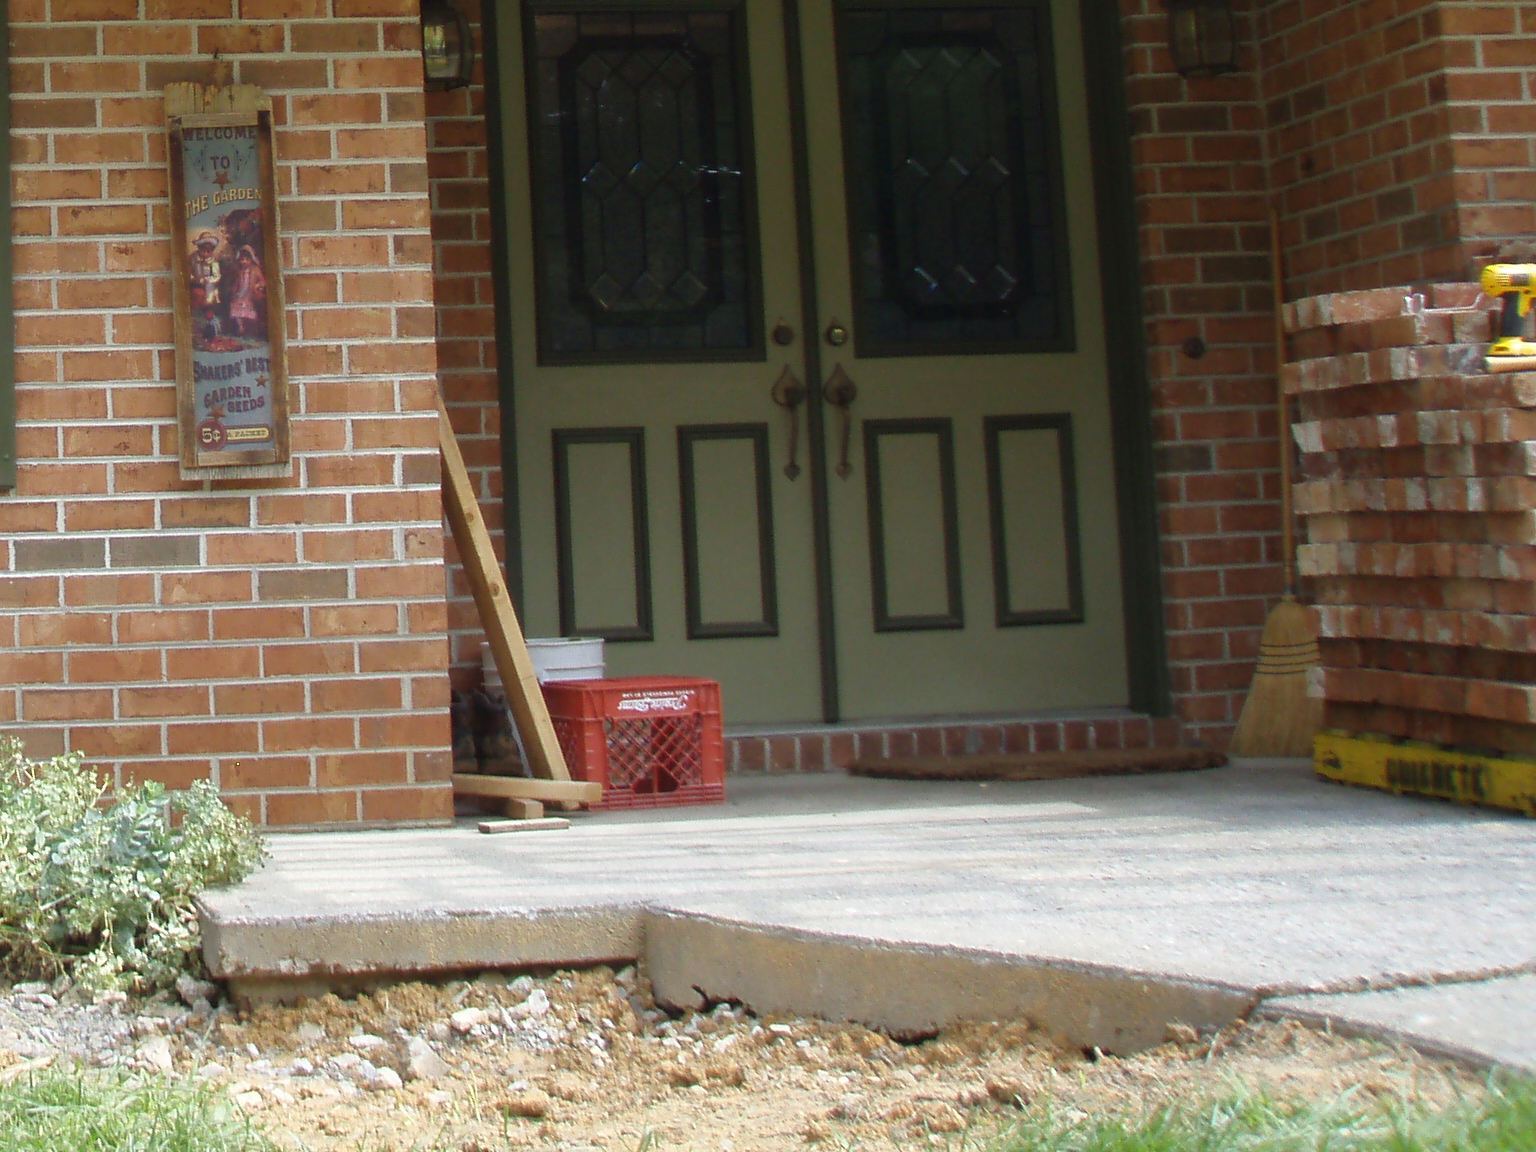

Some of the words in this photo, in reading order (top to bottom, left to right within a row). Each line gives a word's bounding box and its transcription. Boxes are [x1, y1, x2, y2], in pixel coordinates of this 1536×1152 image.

[183, 127, 256, 141] WELCOME
[210, 155, 231, 170] TO
[185, 194, 209, 220] THE
[213, 188, 263, 206] GARDEN
[245, 356, 270, 374] BEST
[204, 386, 251, 408] GARDEN
[227, 395, 265, 413] SEEDS
[202, 428, 221, 444] 5¢
